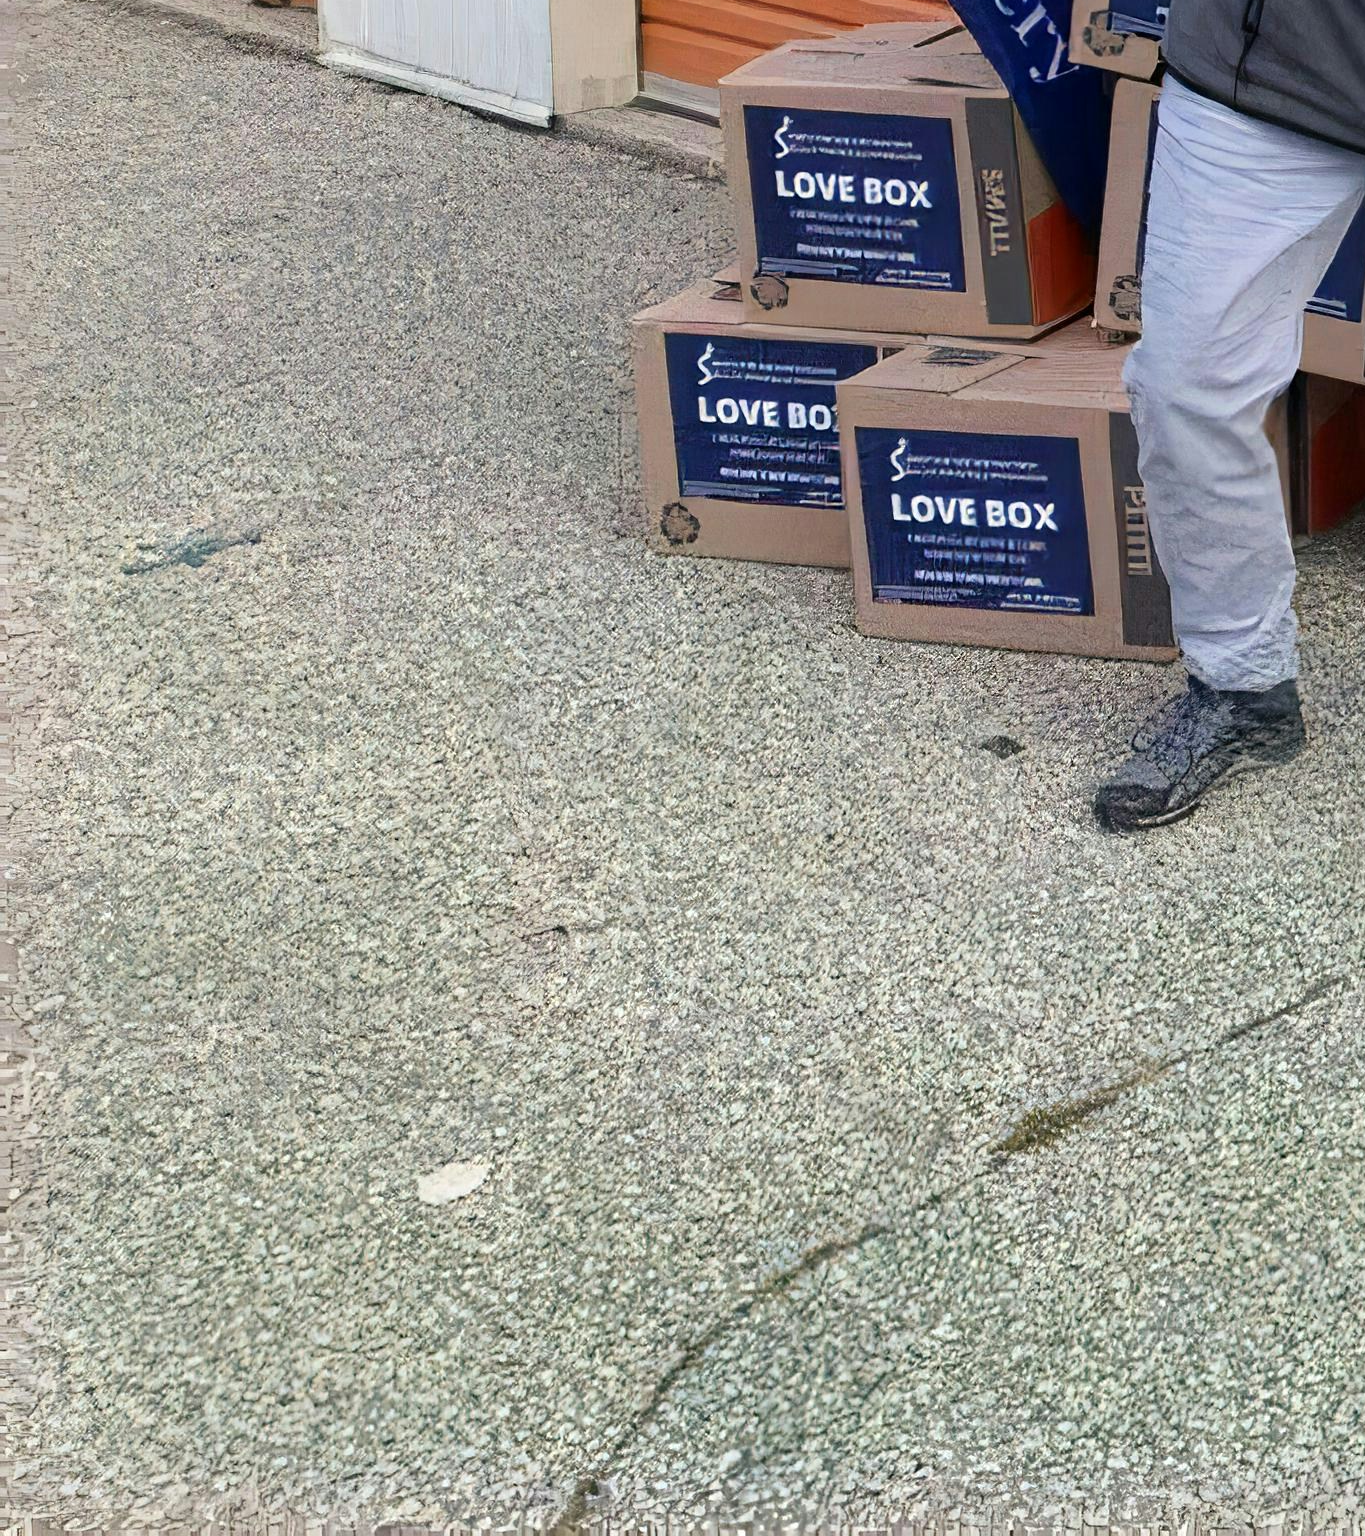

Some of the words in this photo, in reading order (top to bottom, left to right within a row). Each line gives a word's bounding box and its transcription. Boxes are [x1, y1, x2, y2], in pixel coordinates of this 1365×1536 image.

[775, 171, 855, 201] LOVE
[864, 178, 933, 208] BOX
[698, 396, 780, 427] LOVE
[891, 493, 978, 527] LOVE
[985, 499, 1059, 531] BOX
